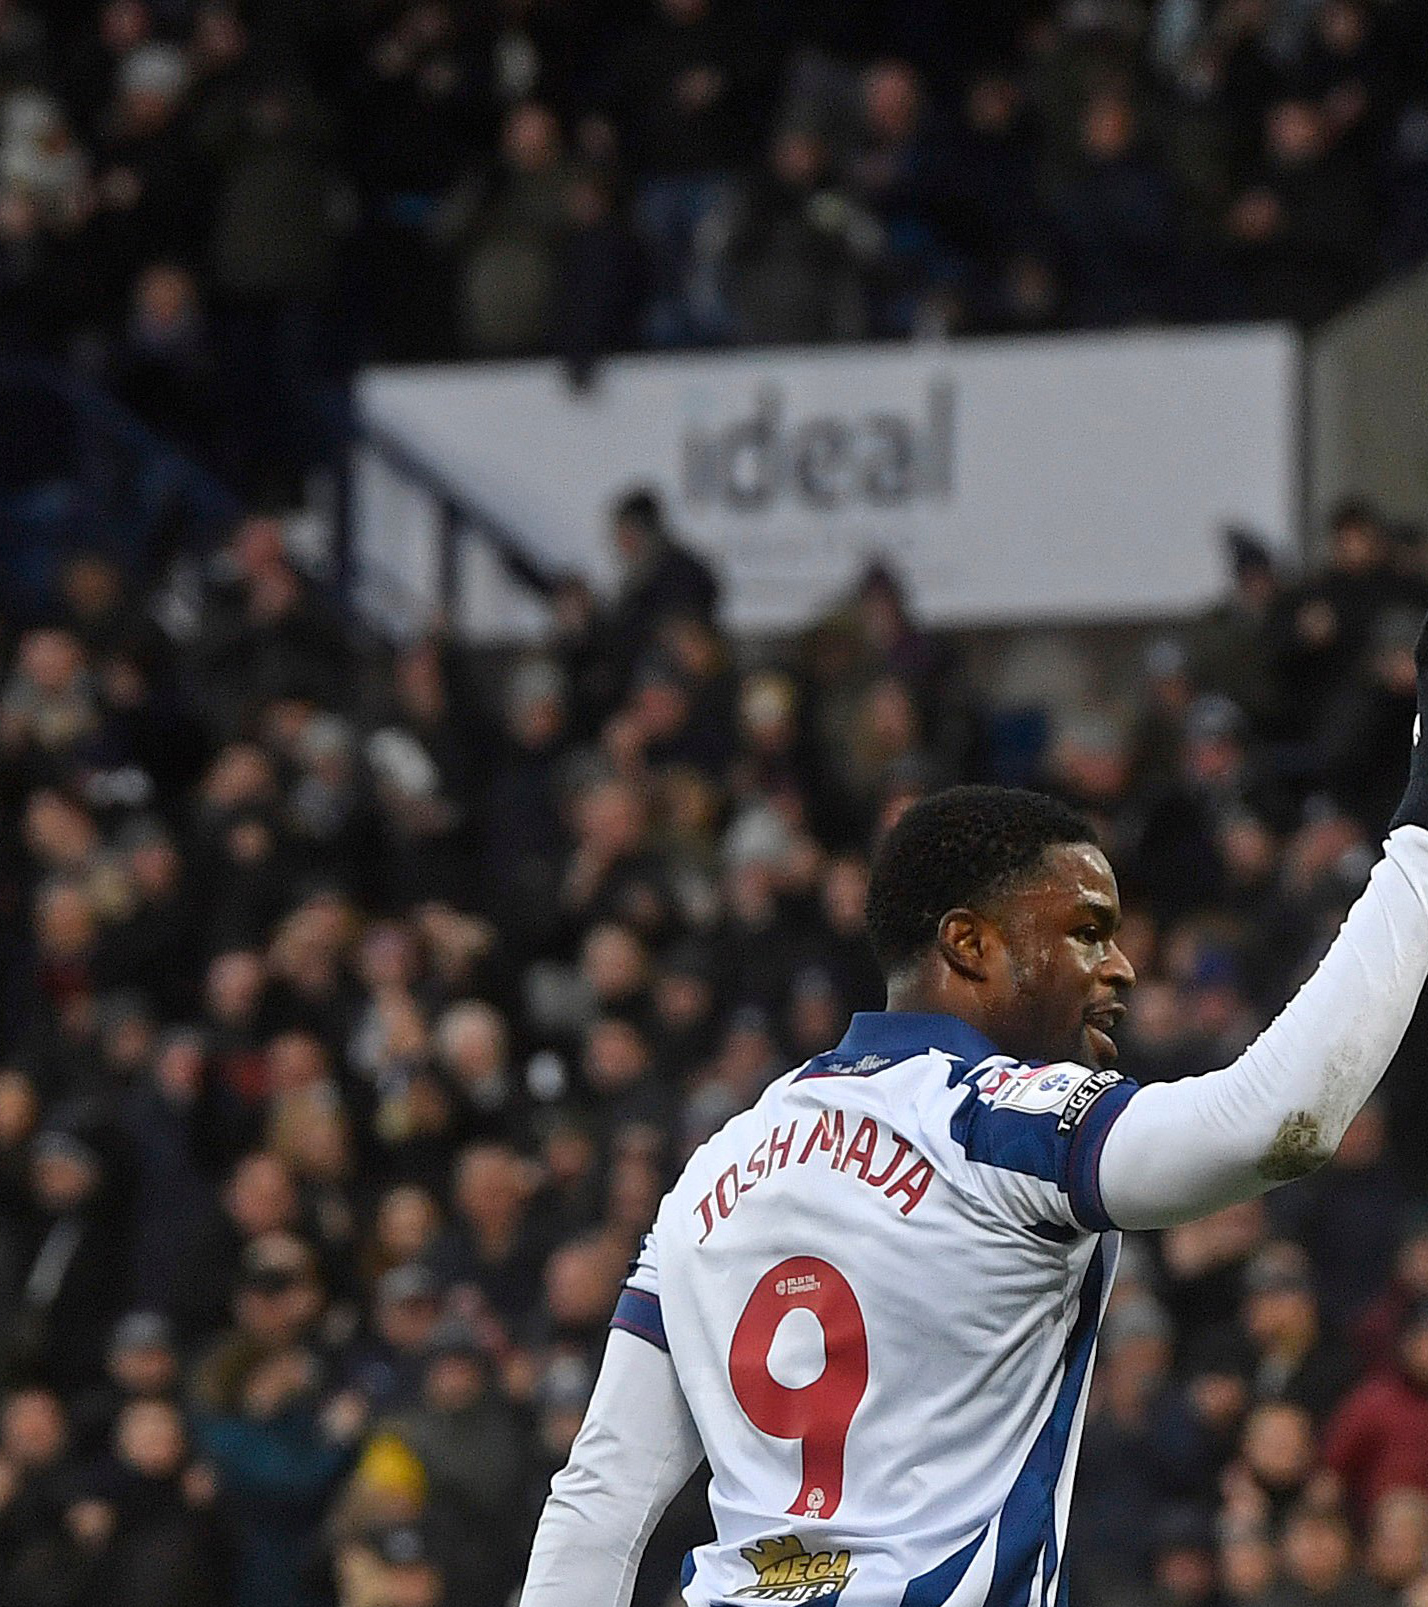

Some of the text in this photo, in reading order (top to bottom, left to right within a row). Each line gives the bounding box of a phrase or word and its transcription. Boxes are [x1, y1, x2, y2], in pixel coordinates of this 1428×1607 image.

[681, 374, 963, 515] ideal
[692, 1109, 935, 1245] JOSH MAJA
[728, 1255, 869, 1519] 9
[757, 1549, 851, 1588] MEGA
